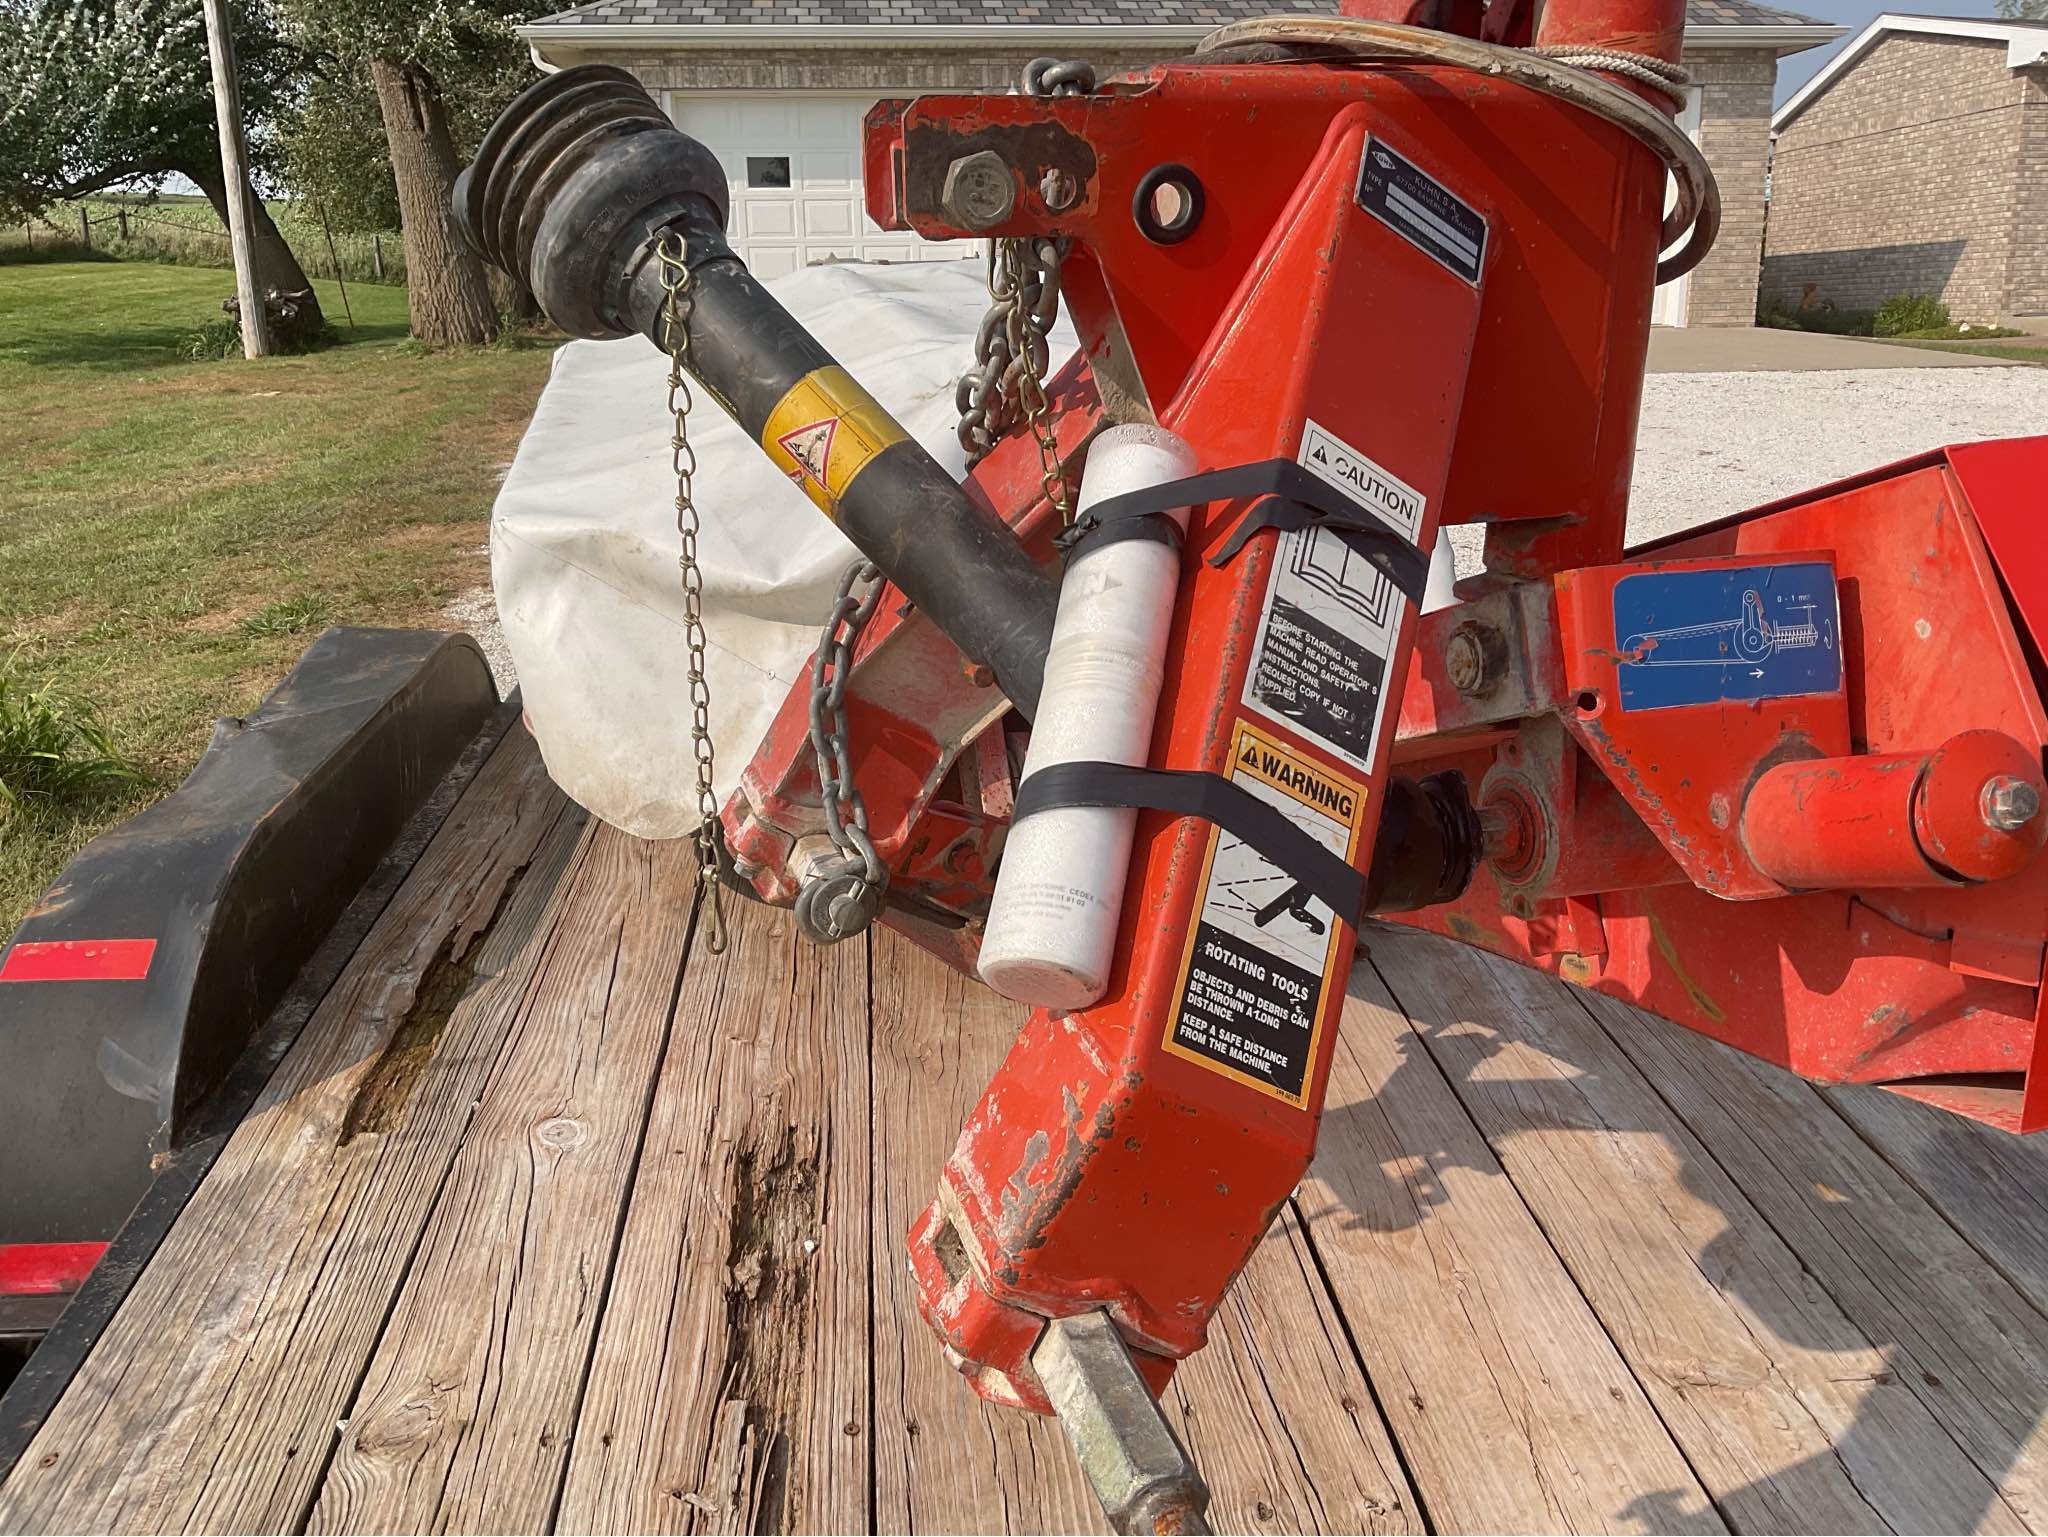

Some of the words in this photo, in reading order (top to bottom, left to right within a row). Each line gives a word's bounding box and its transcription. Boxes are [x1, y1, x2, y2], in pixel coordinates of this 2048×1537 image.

[1368, 171, 1382, 185] TYPE
[1374, 152, 1393, 168] KUHN
[1415, 176, 1440, 199] KUHN
[1335, 457, 1413, 520] CAUTION
[1267, 638, 1298, 662] MANUAL
[1302, 659, 1318, 673] AND
[1320, 669, 1351, 691] SAFETY
[1269, 626, 1303, 651] MACHINE
[1305, 647, 1327, 665] READ
[1272, 614, 1302, 638] BEFORE
[1305, 633, 1342, 660] STARTING
[1344, 656, 1359, 671] THE
[1258, 676, 1297, 703] SUPPLIED.
[1261, 663, 1297, 689] REQUEST
[1300, 685, 1320, 702] COPY
[1323, 698, 1331, 707] IF
[1332, 702, 1348, 719] NOT
[1264, 651, 1320, 689] INSTRUCTIONS.
[1262, 752, 1352, 818] WARNING
[1204, 942, 1265, 981] ROTATING
[1272, 973, 1309, 1001] TOOLS
[1187, 993, 1234, 1022] DISTANCE.
[1190, 980, 1202, 994] BE
[1206, 986, 1244, 1012] THROWN
[1246, 1007, 1253, 1016] A
[1255, 1012, 1280, 1030] LONG
[1193, 968, 1234, 995] OBJECTS
[1236, 989, 1255, 1004] AND
[1257, 998, 1288, 1020] DEBRIS
[1291, 1013, 1309, 1029] CAN
[1180, 1025, 1206, 1045] FROM
[1209, 1037, 1227, 1054] THE
[1229, 1047, 1272, 1074] MACHINE.
[1183, 1013, 1208, 1030] KEEP
[1209, 1025, 1216, 1036] A
[1218, 1029, 1242, 1047] SAFE
[1244, 1040, 1288, 1068] DISTANCE
